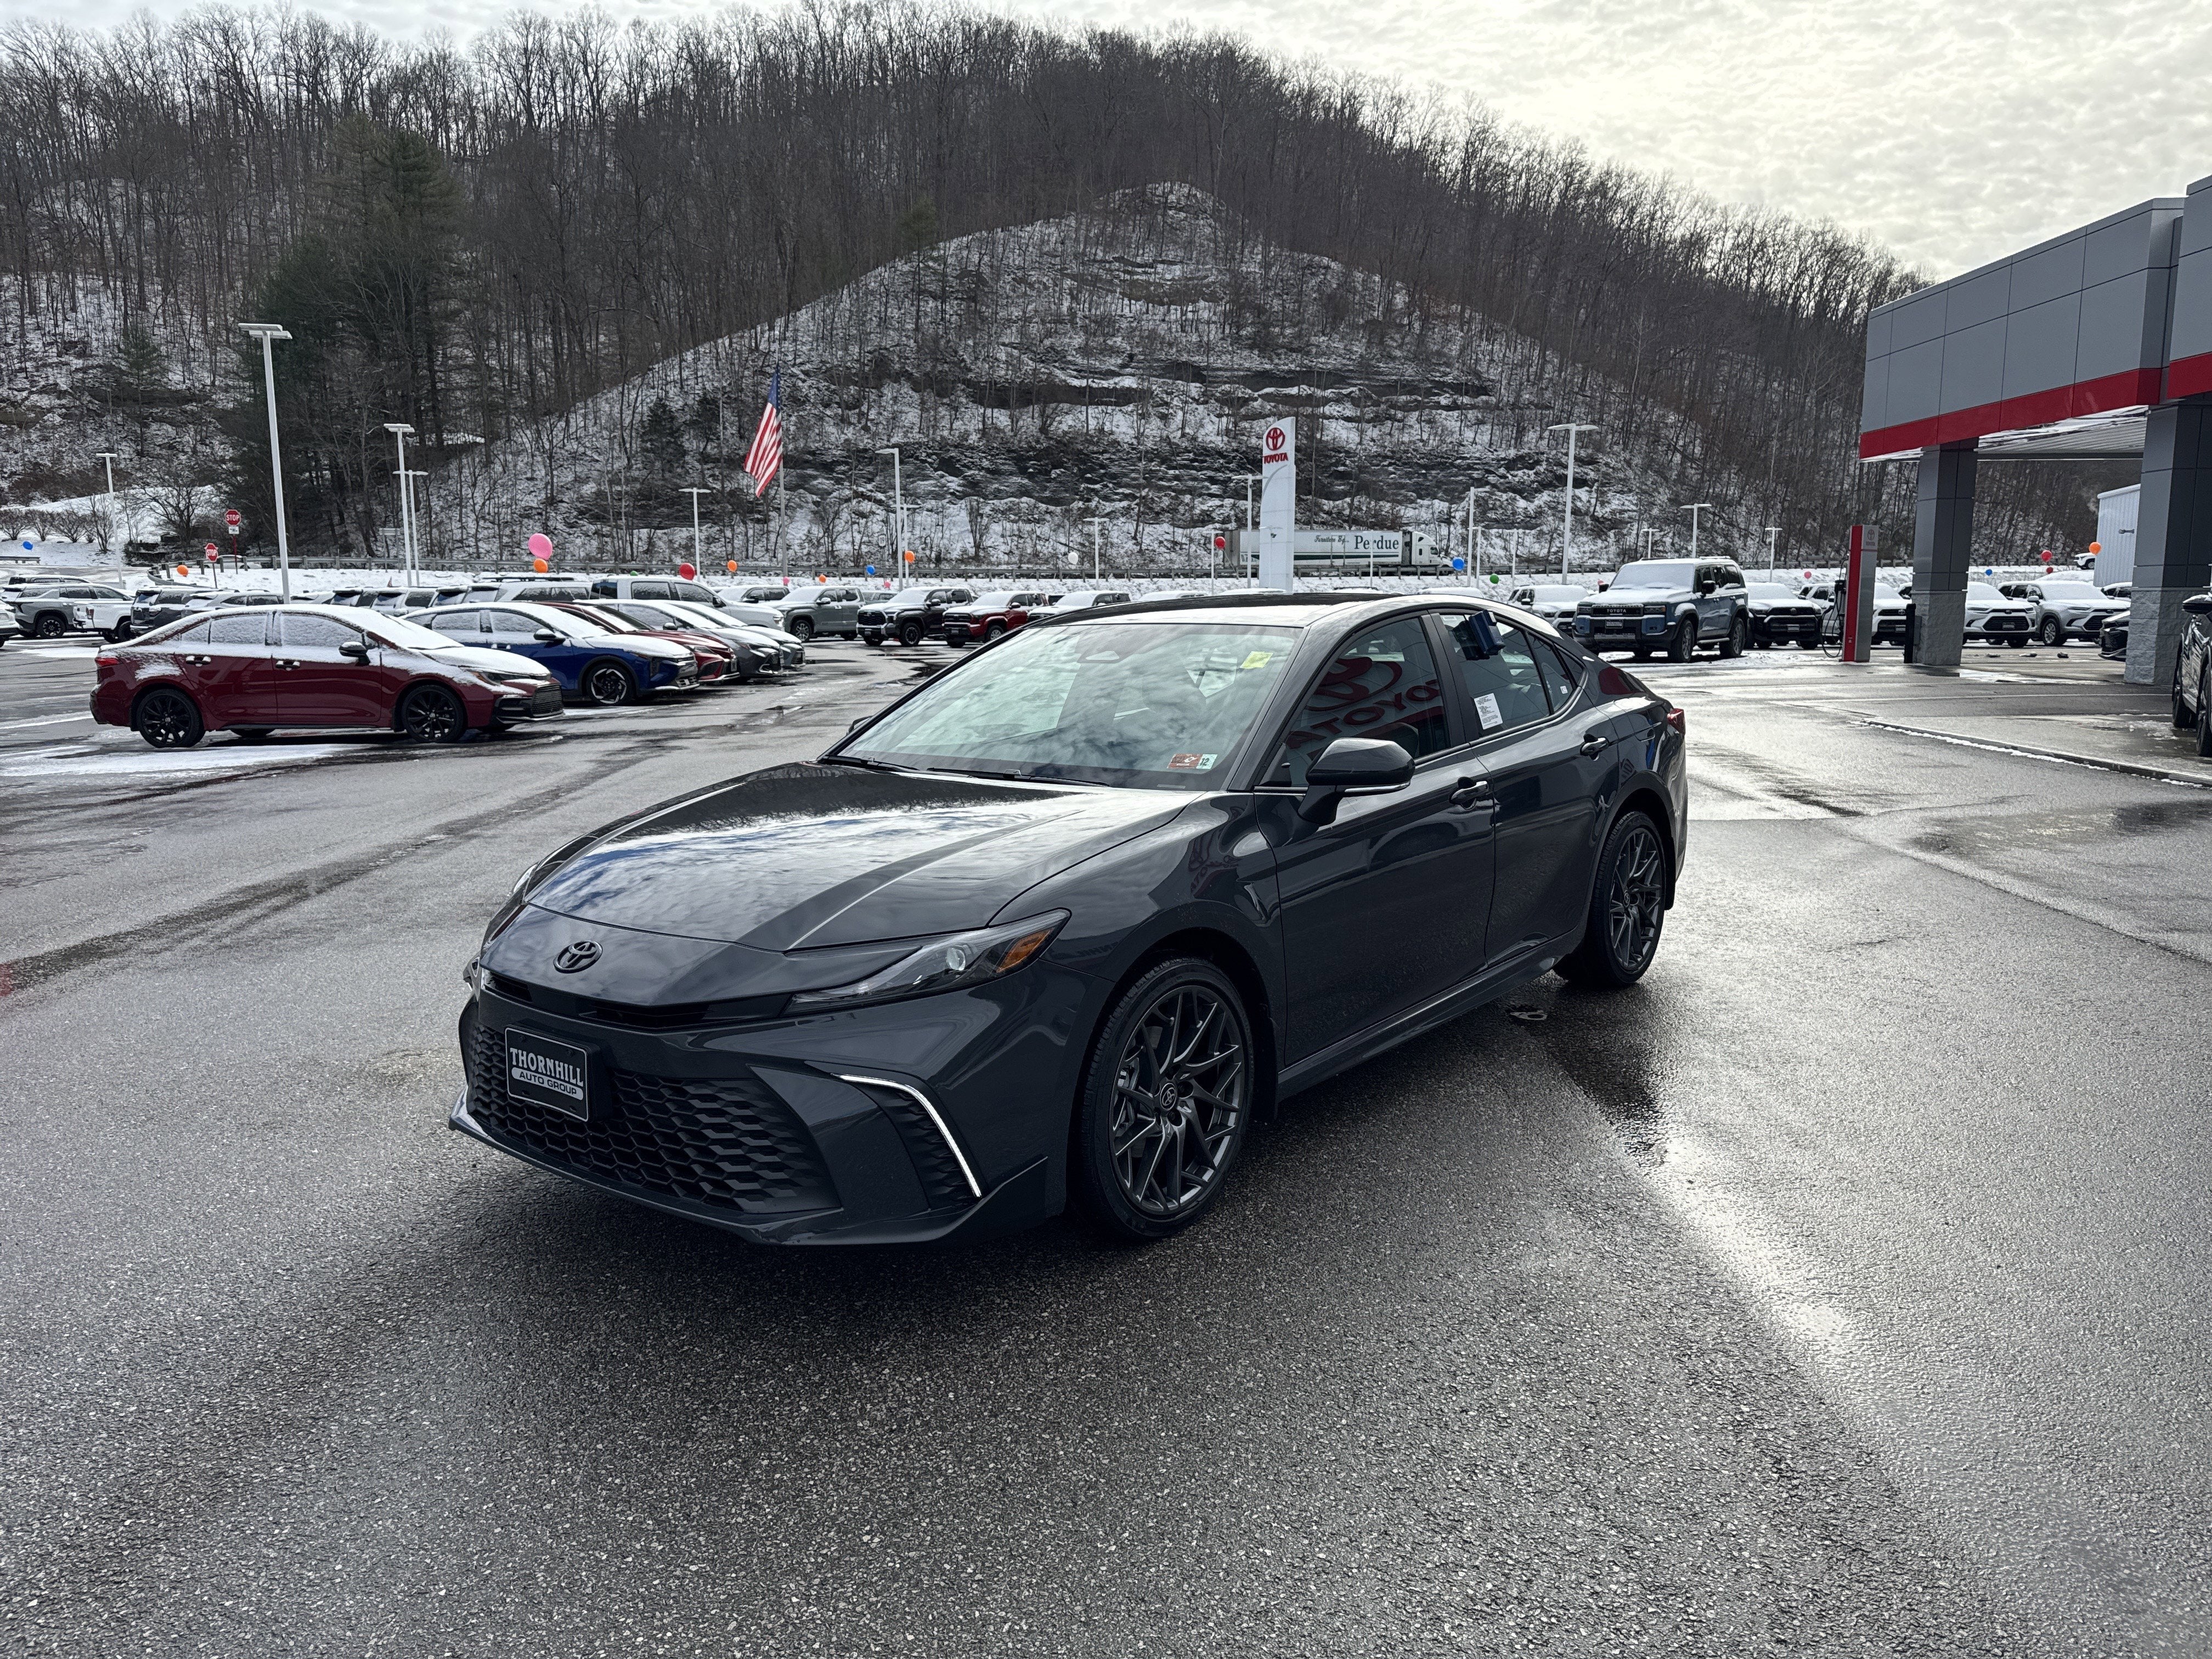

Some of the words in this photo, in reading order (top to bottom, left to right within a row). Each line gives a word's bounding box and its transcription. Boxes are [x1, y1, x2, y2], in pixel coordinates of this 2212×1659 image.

[1262, 453, 1289, 464] TOYOTA
[1199, 758, 1210, 766] 12
[510, 1047, 584, 1087] THORNHILL
[520, 1071, 544, 1085] AUTO
[547, 1079, 577, 1095] GROUP
